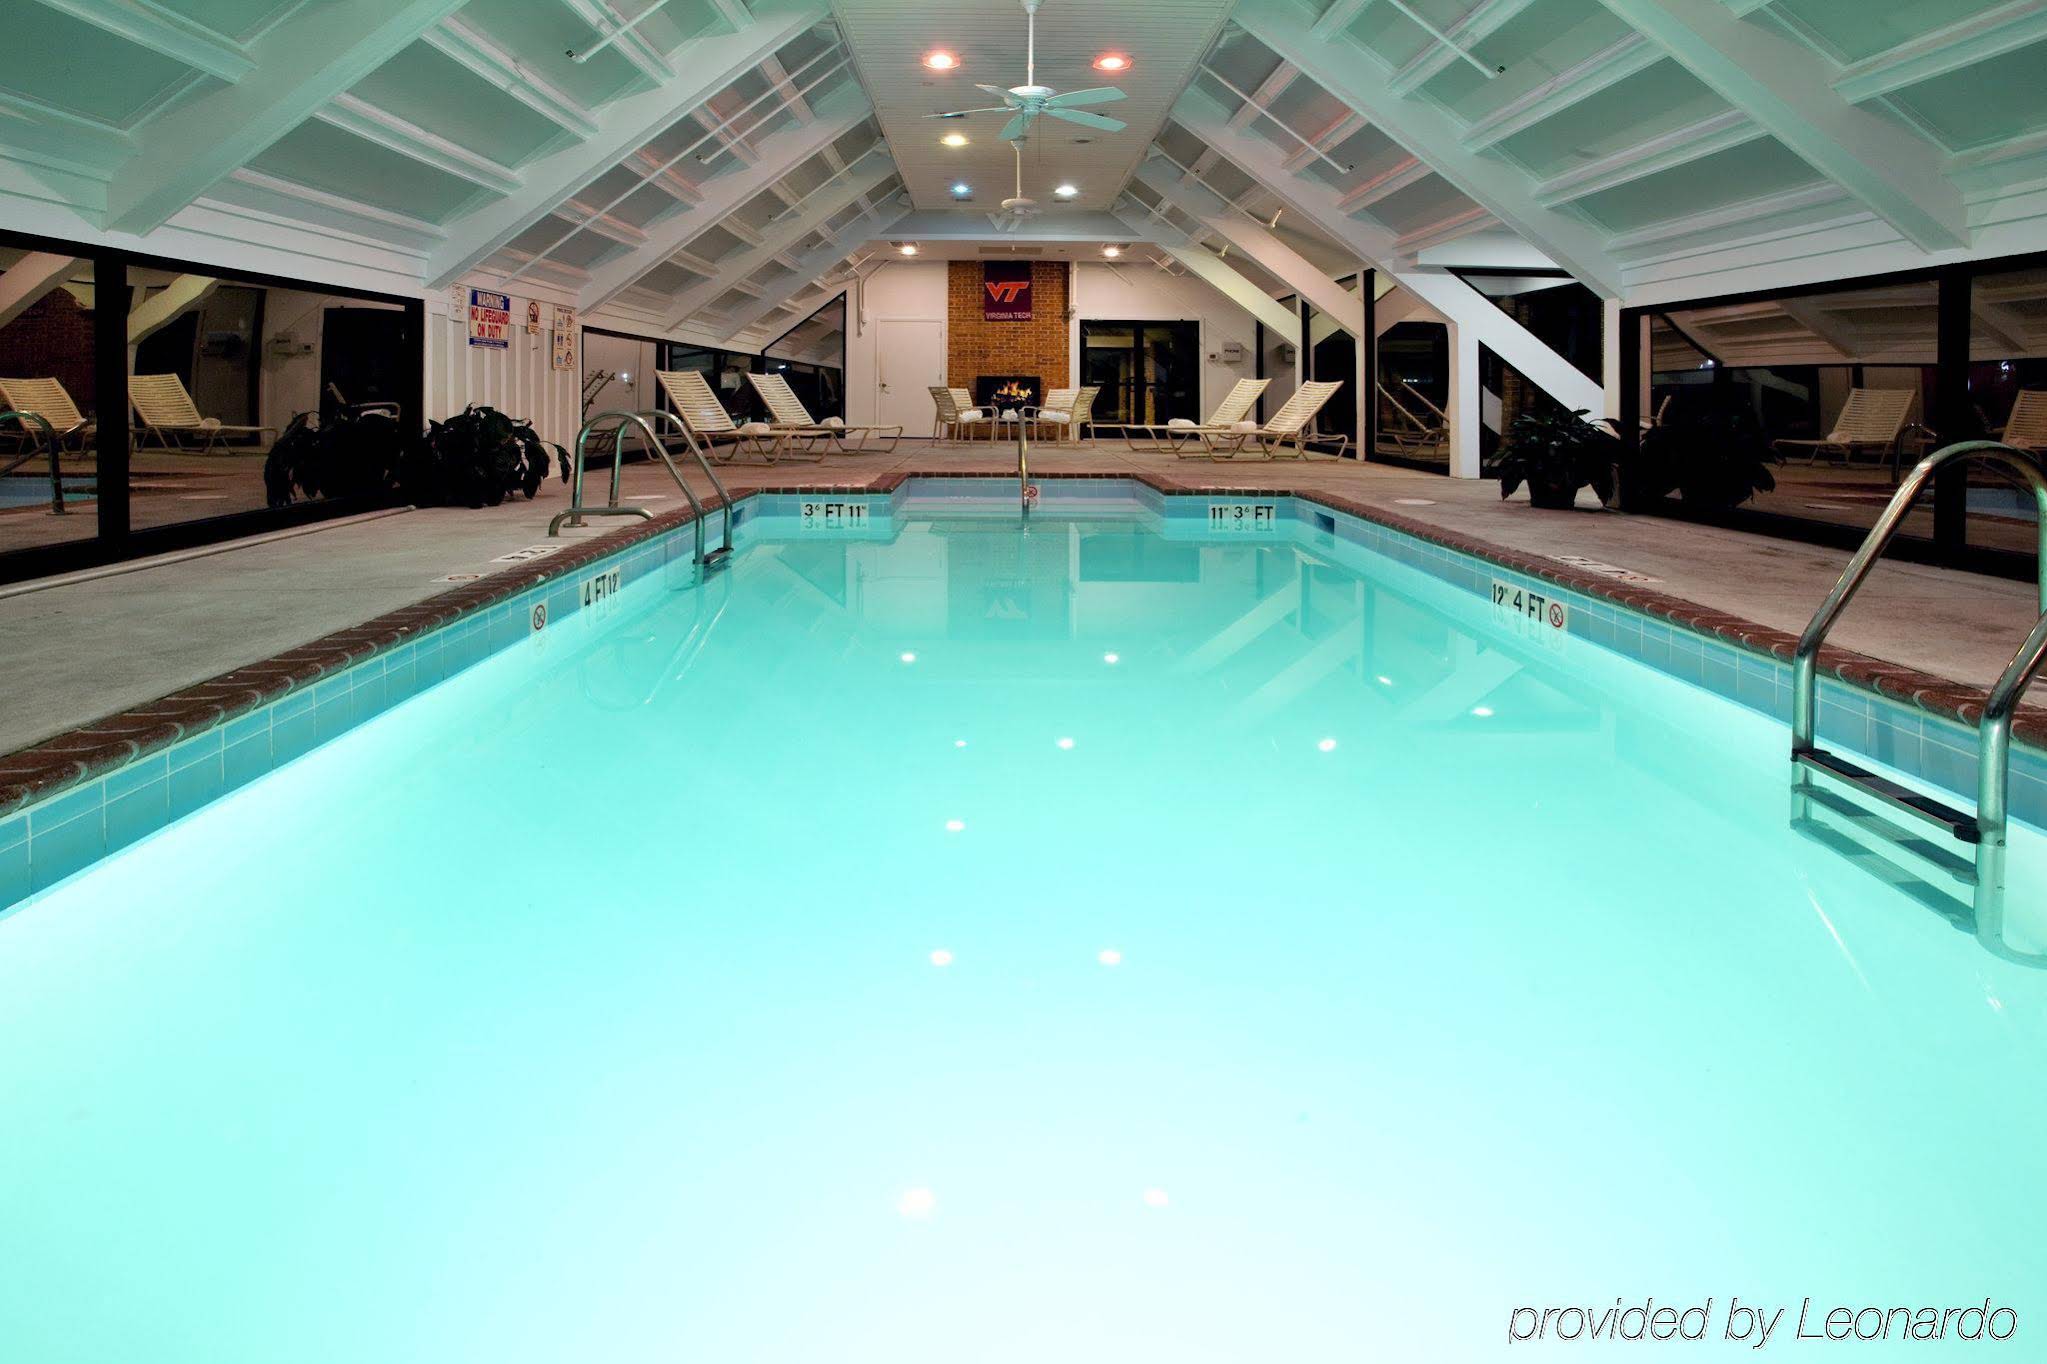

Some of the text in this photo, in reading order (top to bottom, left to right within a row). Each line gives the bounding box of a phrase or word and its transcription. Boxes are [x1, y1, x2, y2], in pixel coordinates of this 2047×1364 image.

[477, 291, 505, 309] WARNING
[985, 281, 1030, 303] VT
[471, 306, 509, 325] NO LIFEGUARD
[985, 312, 1013, 320] VIRGINIA
[477, 323, 502, 339] ON DUTY
[825, 503, 844, 517] FT
[1255, 506, 1273, 520] FT
[584, 581, 591, 607] 4
[595, 574, 607, 603] FT
[1513, 590, 1522, 612] 4
[1528, 593, 1545, 623] FT
